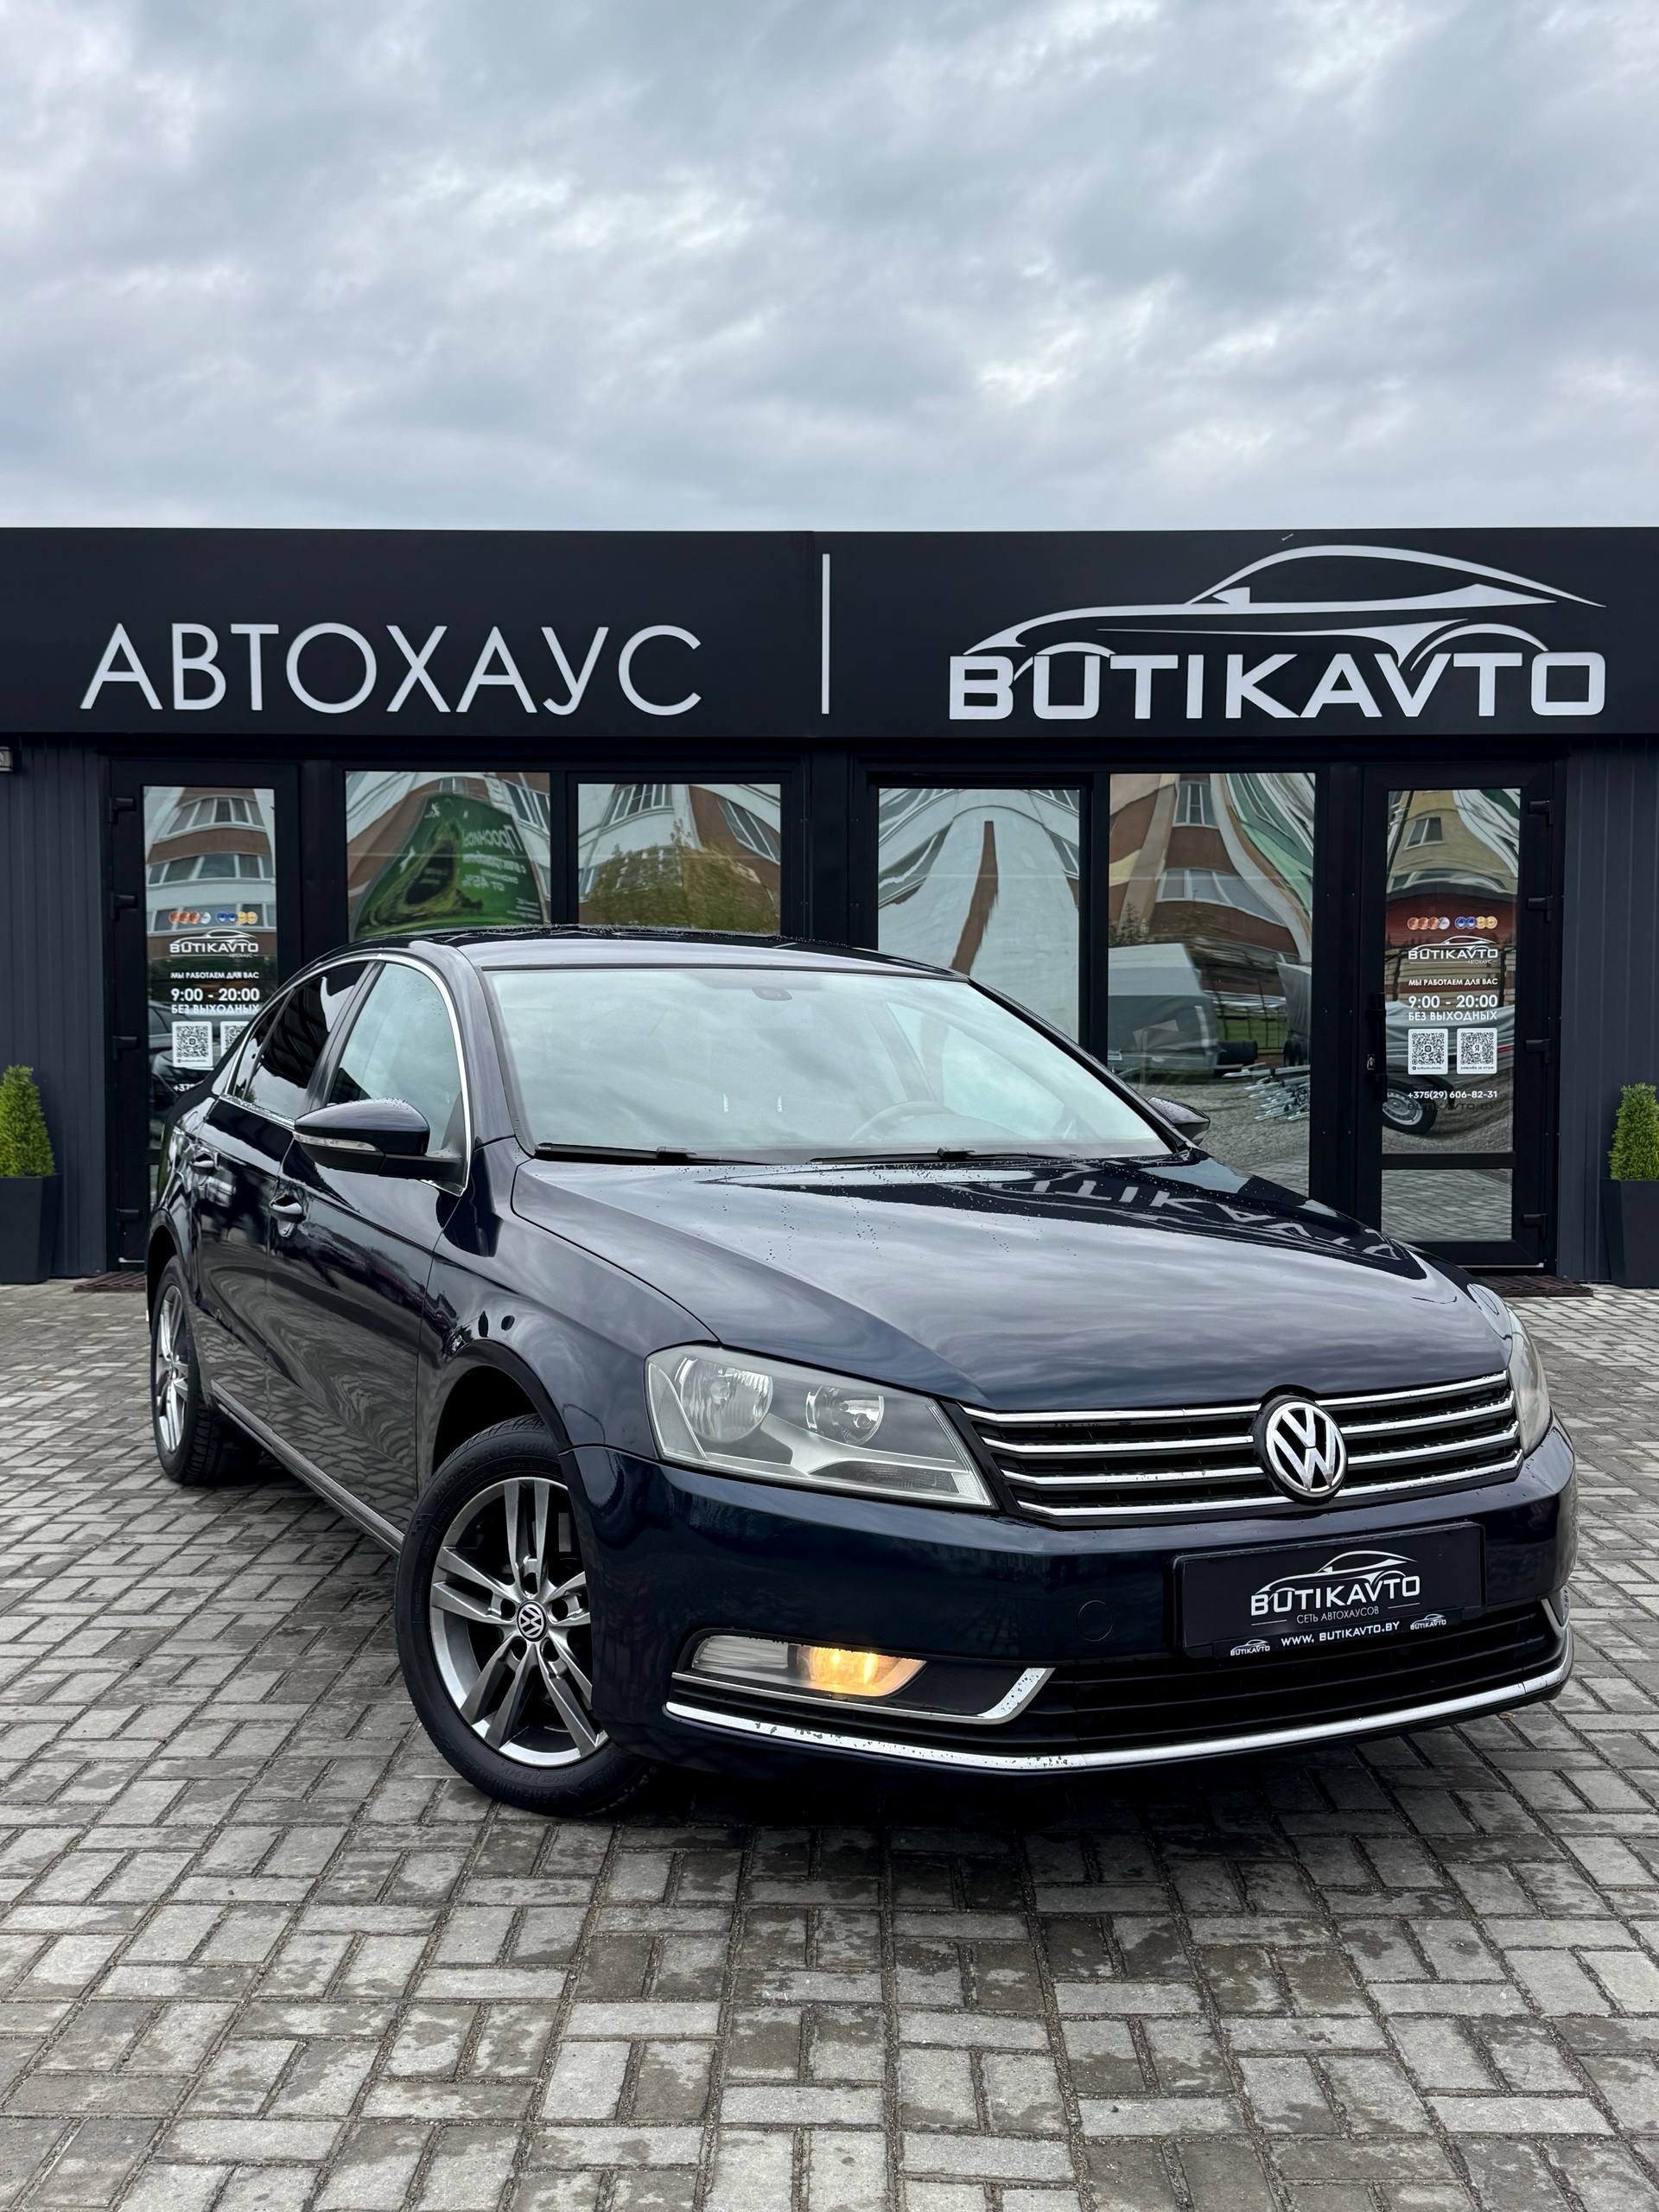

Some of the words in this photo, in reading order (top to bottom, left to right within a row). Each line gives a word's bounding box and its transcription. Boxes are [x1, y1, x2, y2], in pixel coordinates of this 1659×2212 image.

[79, 622, 702, 716] АВТОХАУС
[950, 651, 1606, 721] BUTIKAVTO
[169, 943, 259, 953] BUTIKAVTO
[1408, 949, 1498, 960] BUTIKAVTO
[170, 988, 204, 1001] 9:00
[218, 988, 260, 1001] 20:00
[1408, 995, 1440, 1008] 9:00
[1456, 995, 1498, 1007] 20:00
[171, 1004, 189, 1014] БЕЗ
[192, 1004, 259, 1014] ВЫХОДНЫХ
[1408, 1012, 1427, 1021] БЕЗ
[1430, 1011, 1497, 1021] ВЫХОДНЫХ
[1408, 1090, 1447, 1100] +375(29)
[1250, 1574, 1421, 1617] BUTIKAVTO
[1296, 1613, 1319, 1624] СЕТЬ
[1320, 1605, 1380, 1622] АВТОХАУСОВ
[1409, 1618, 1447, 1630] BUTIKAVTO
[1281, 1634, 1315, 1647] WWW.
[1319, 1621, 1401, 1642] BUTIKAVTO.BY
[1230, 1644, 1271, 1656] BUTIKAVTO
